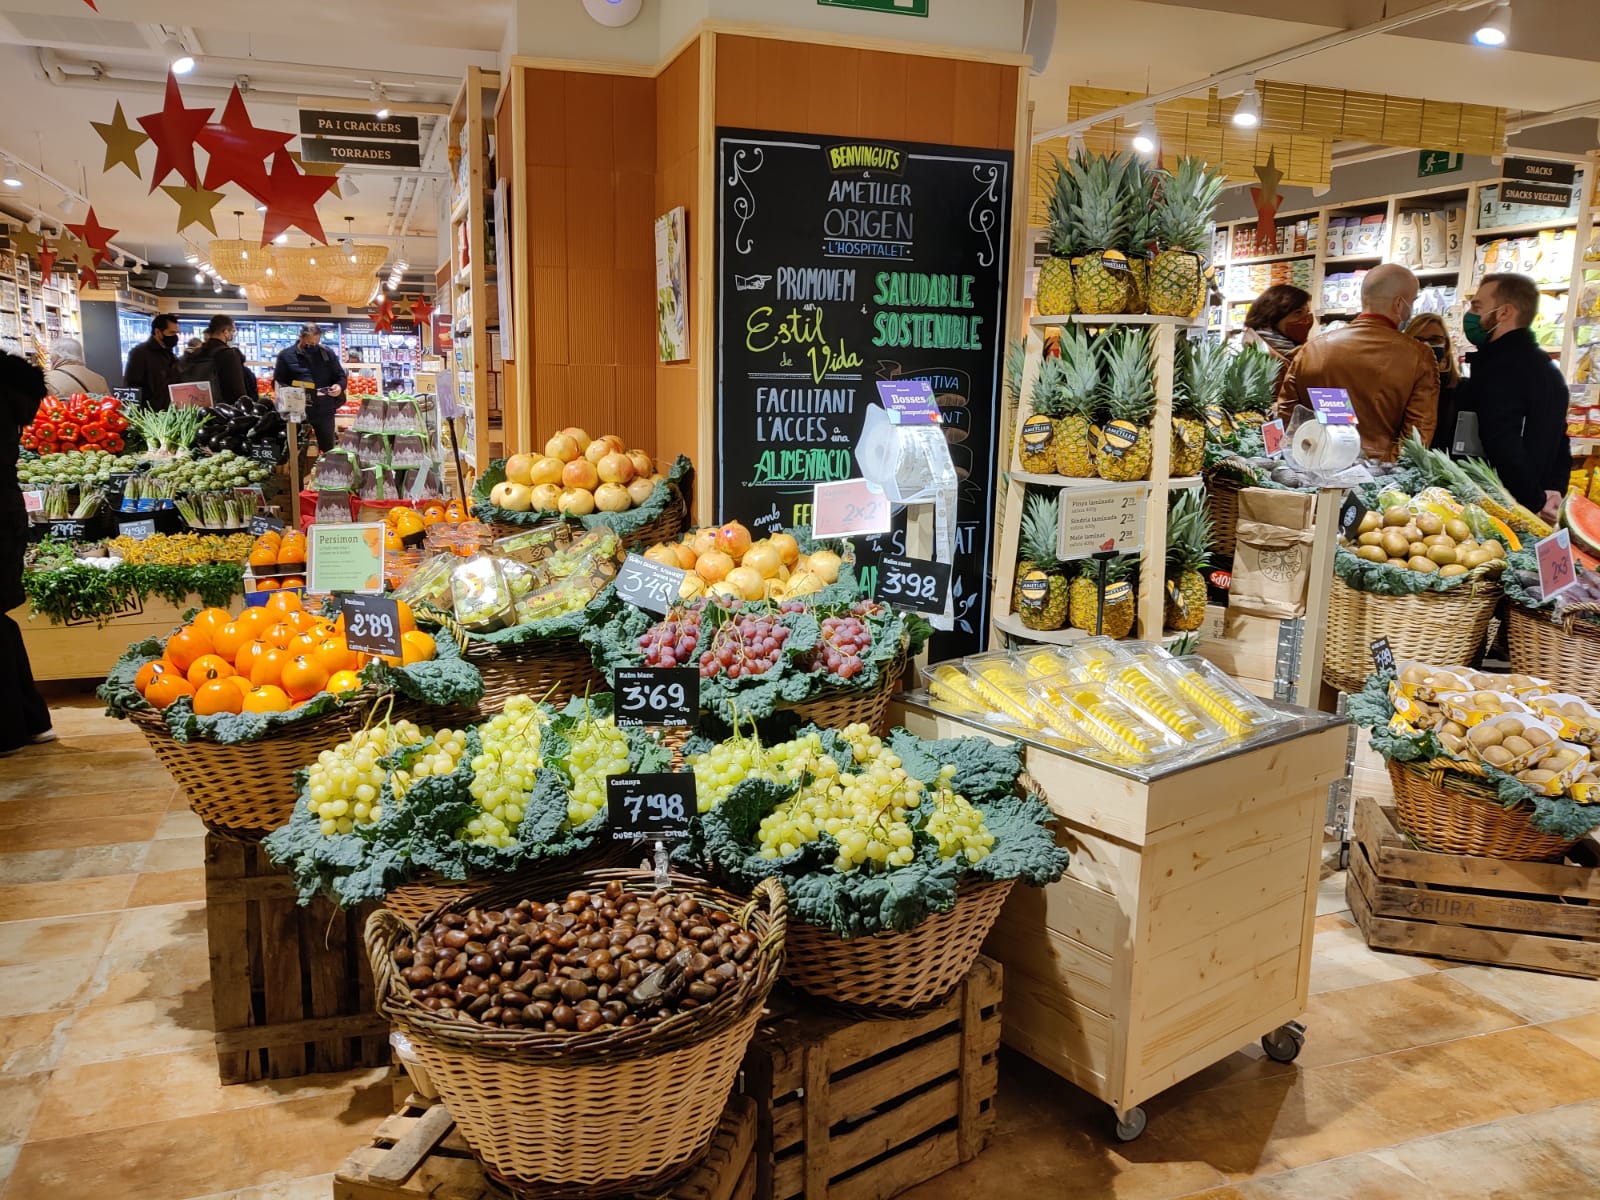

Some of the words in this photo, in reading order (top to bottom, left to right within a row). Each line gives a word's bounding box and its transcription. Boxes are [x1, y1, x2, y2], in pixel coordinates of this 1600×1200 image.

[318, 119, 333, 129] PA
[336, 121, 341, 129] I
[344, 121, 401, 133] CRACKERS
[330, 147, 391, 160] TORRADES
[830, 145, 900, 170] BENVINGUTS
[1525, 165, 1553, 176] SNACKS
[828, 180, 912, 207] AMETLLER
[1505, 189, 1533, 200] SNACKS
[1533, 191, 1568, 203] VEGETALS
[824, 208, 914, 239] ORIGEN
[777, 267, 856, 301] PROMOVEM
[873, 271, 976, 308] SALUDABLE
[746, 306, 826, 352] Estil
[872, 311, 984, 350] SOSTENIBLE
[779, 352, 793, 367] de
[807, 338, 864, 384] Vida
[757, 387, 856, 414] FACILITANT
[890, 394, 927, 404] Bosses
[754, 502, 780, 526] amb
[320, 534, 359, 545] Persimon
[349, 613, 394, 638] 2'89
[637, 671, 654, 679] blanc
[621, 683, 685, 710] 3'69
[610, 778, 641, 786] Castanya
[624, 793, 685, 823] 7'98
